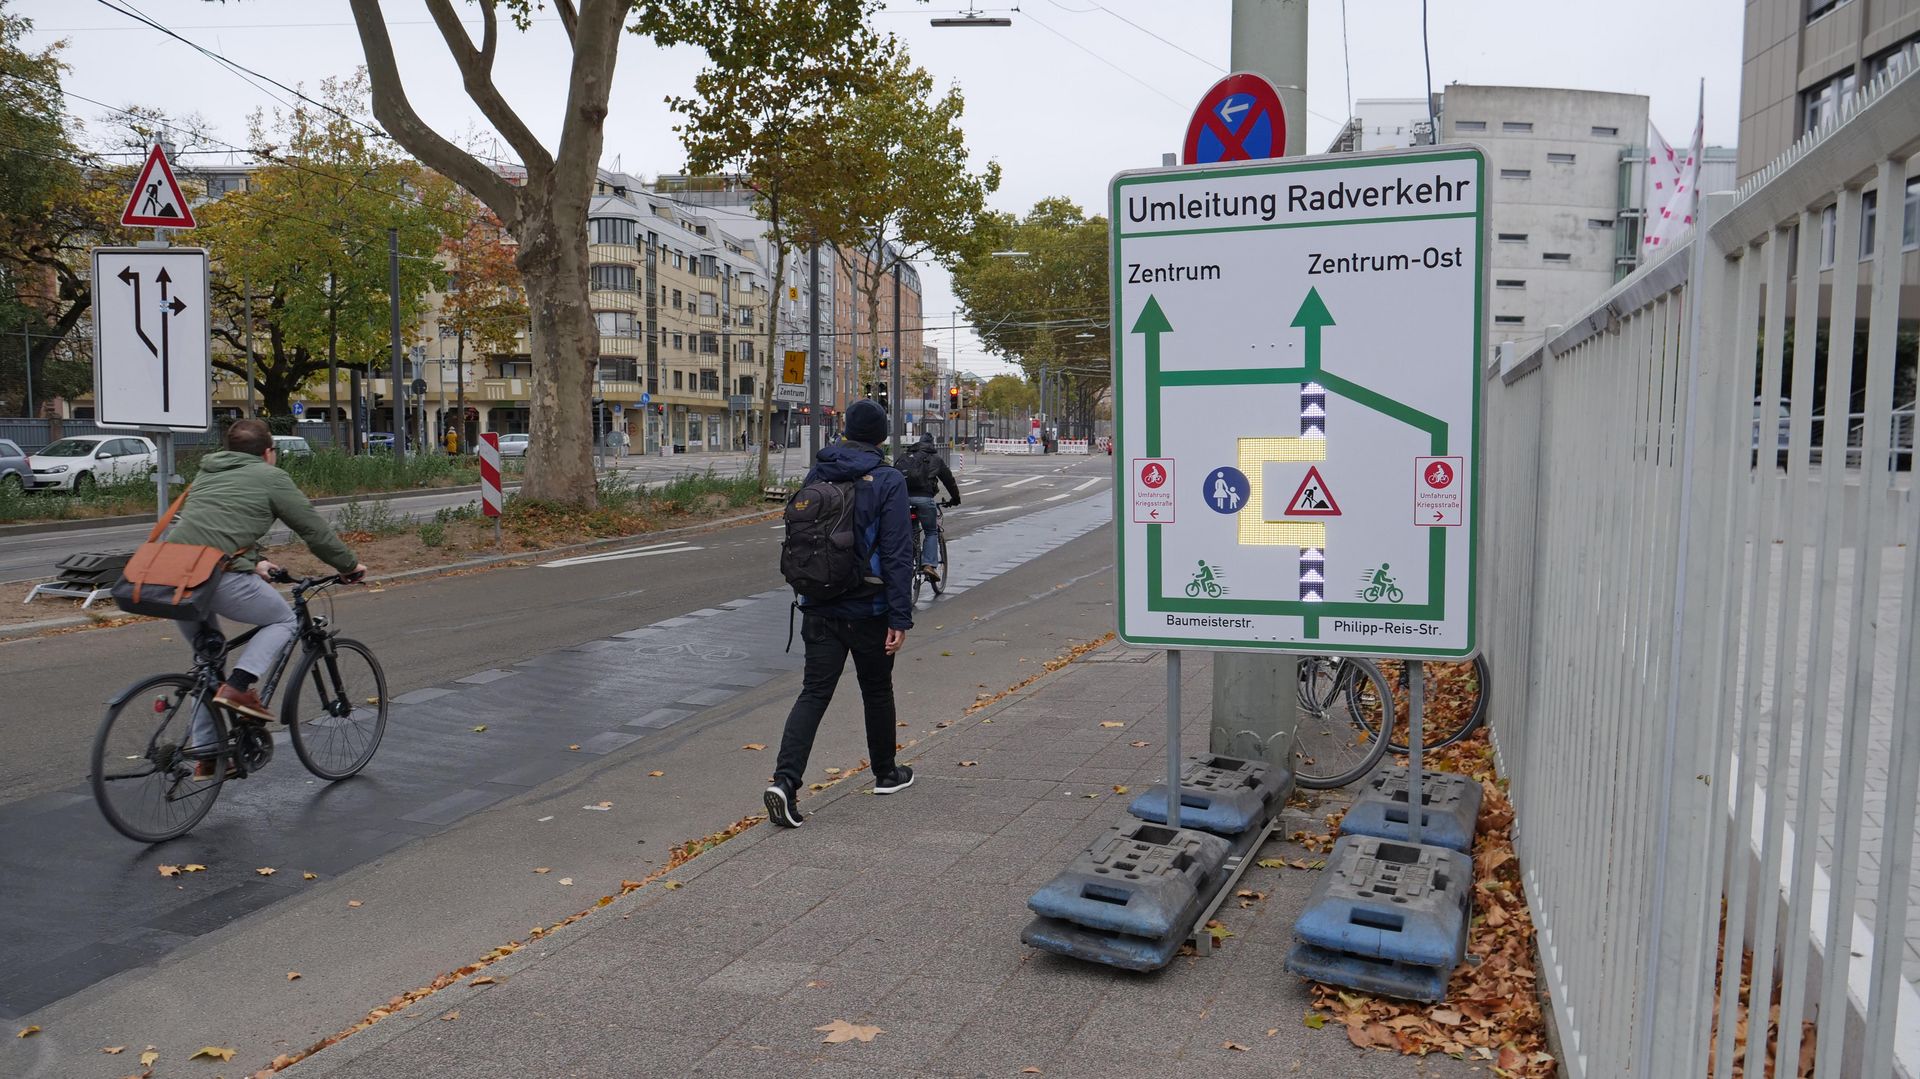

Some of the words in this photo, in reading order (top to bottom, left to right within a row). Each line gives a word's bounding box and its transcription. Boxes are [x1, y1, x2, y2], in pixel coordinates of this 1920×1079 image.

[1128, 191, 1277, 223] Umleitung
[1288, 175, 1471, 212] Radverkehr
[1308, 247, 1463, 275] Zentrum-Ost
[1128, 263, 1221, 284] Zentrum
[790, 288, 796, 298] 3
[780, 387, 805, 398] Zentrum
[1135, 500, 1173, 508] Kriegsstraße
[1416, 501, 1460, 509] Kriegsstraße
[1166, 614, 1255, 629] Baumeisterstr.
[1334, 620, 1443, 636] Philipp-Reis-Str.
